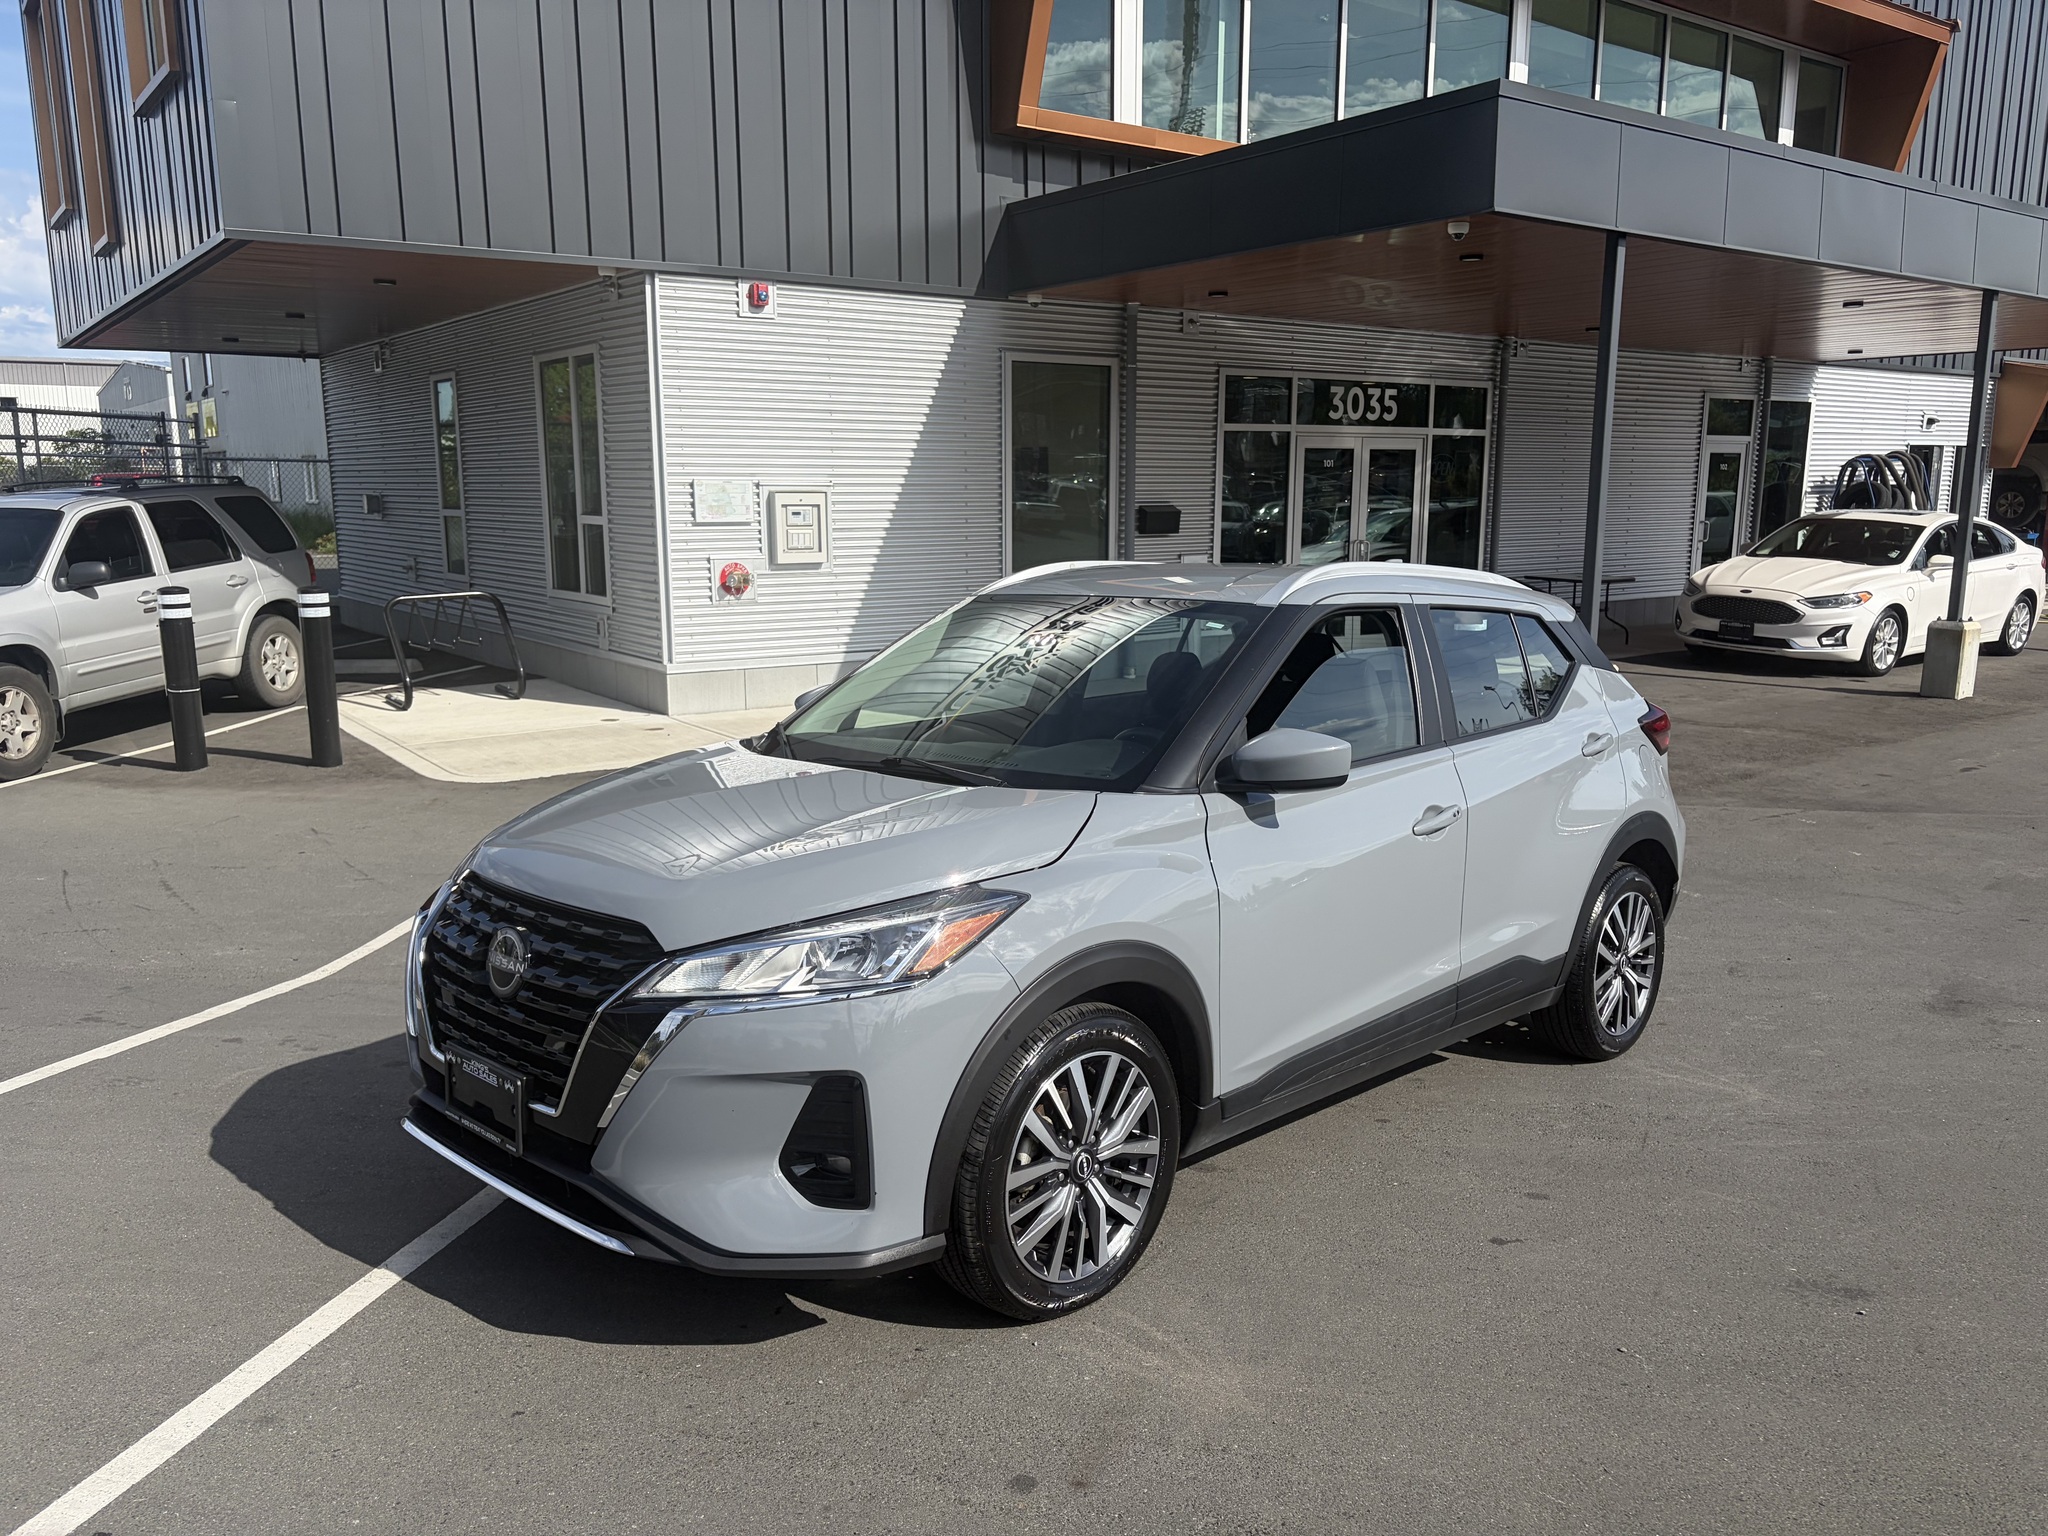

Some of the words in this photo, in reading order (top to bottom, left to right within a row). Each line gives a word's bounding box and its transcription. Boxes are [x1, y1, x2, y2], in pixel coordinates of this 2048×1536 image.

[1328, 386, 1399, 422] 3035
[1323, 459, 1334, 468] 101
[487, 951, 525, 974] NISSAN
[462, 1062, 479, 1075] AUTO
[478, 1069, 498, 1085] SALES
